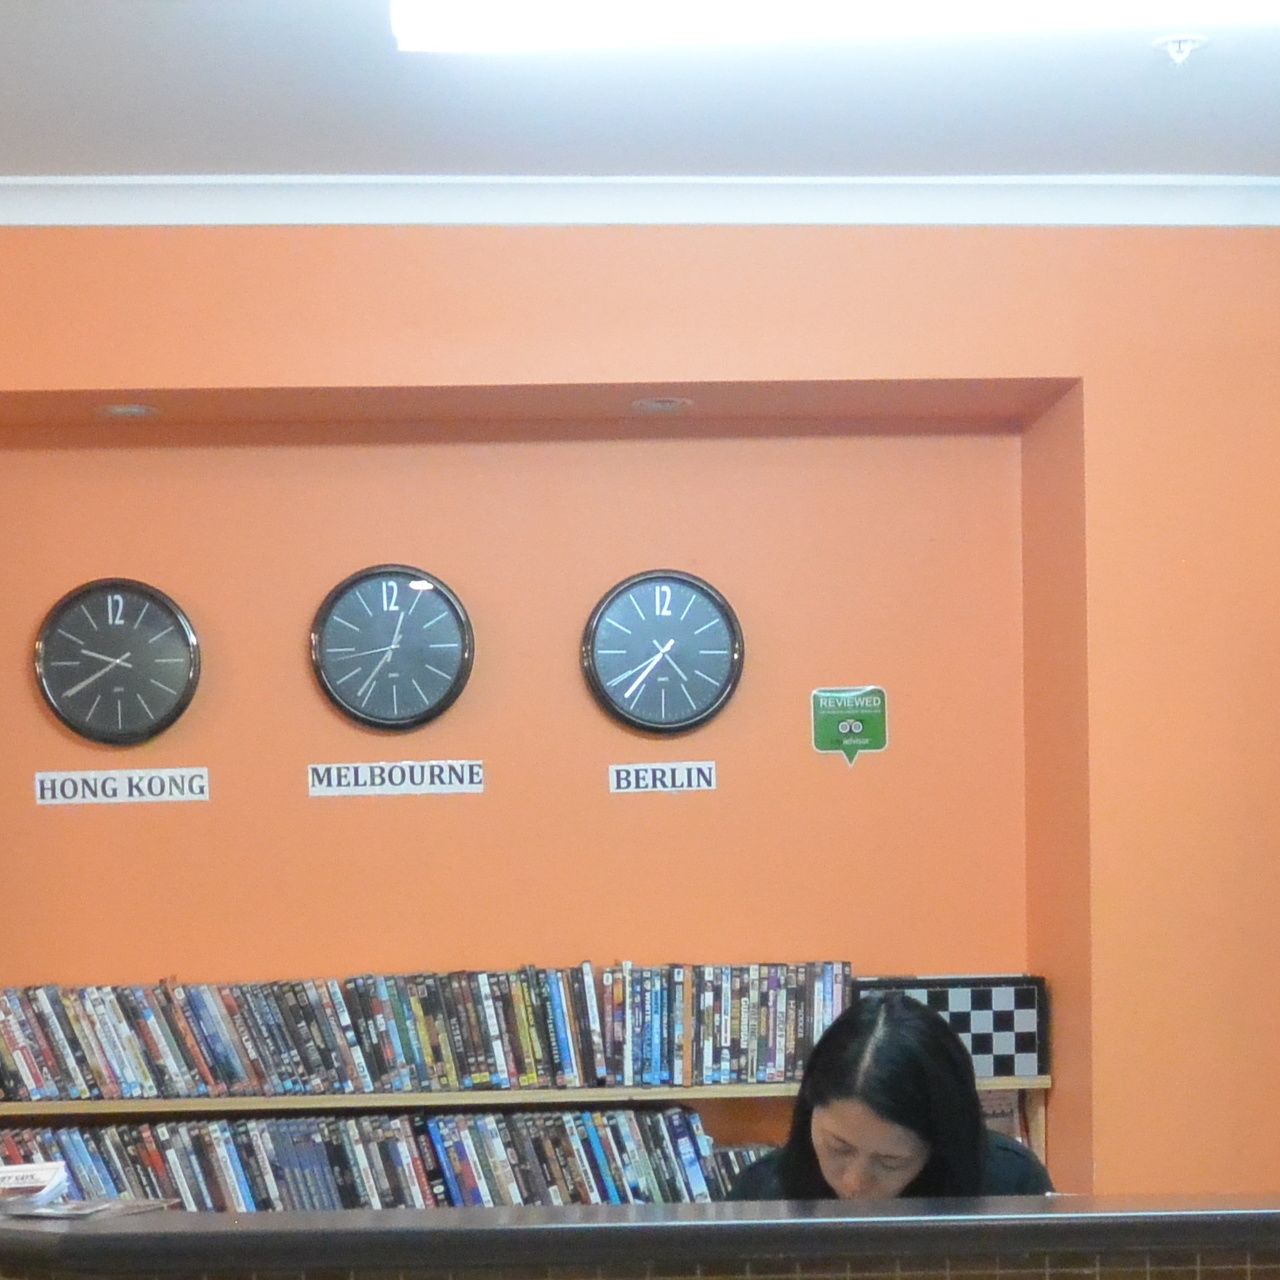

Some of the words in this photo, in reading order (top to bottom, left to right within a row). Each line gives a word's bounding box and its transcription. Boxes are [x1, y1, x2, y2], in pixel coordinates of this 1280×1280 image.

[107, 594, 125, 625] 12
[382, 582, 399, 611] 12
[654, 585, 672, 616] 12
[820, 696, 881, 708] REVIEWED
[38, 777, 117, 800] HONG
[127, 773, 206, 797] KONG
[311, 762, 483, 788] MELBOURNE
[614, 766, 713, 790] BERLIN
